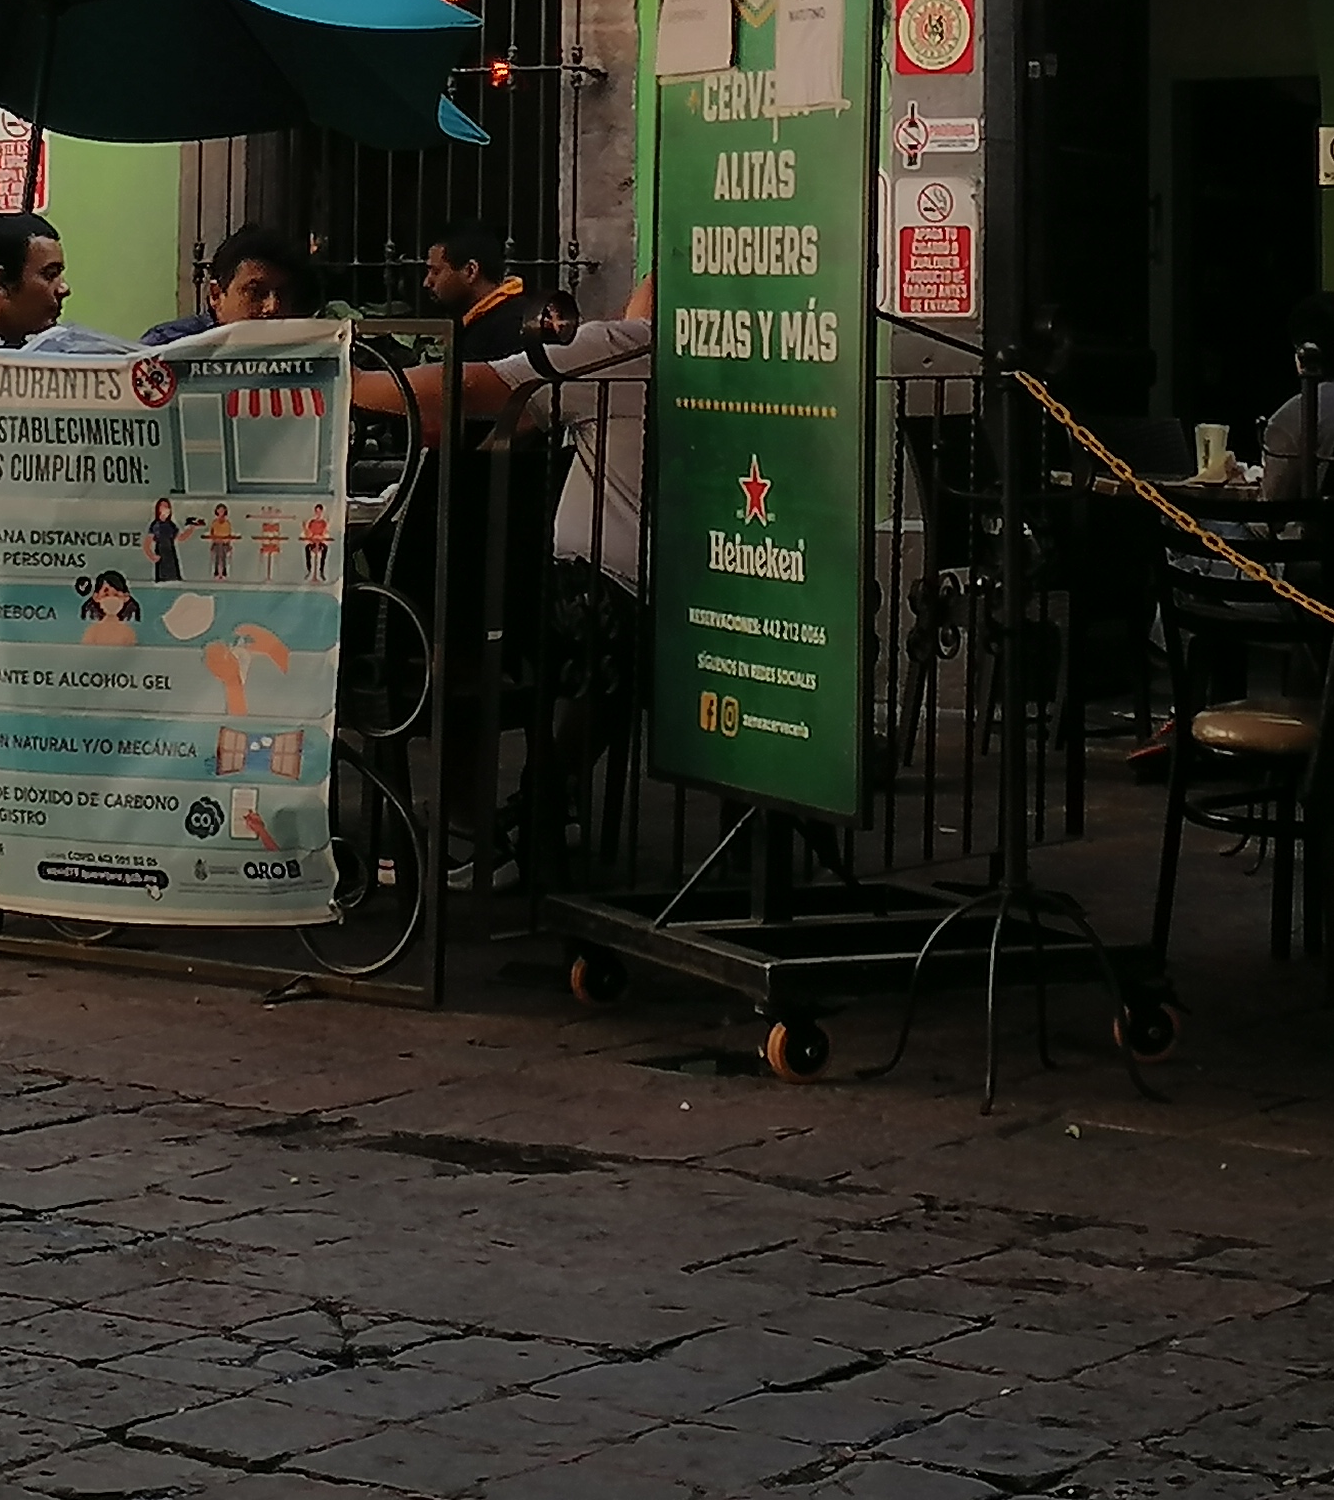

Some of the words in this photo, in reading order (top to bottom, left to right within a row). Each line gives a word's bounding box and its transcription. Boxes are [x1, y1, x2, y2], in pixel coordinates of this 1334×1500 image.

[702, 71, 810, 122] CERVE
[714, 150, 797, 201] ALITAS
[691, 225, 819, 276] BURGUERS
[675, 308, 752, 359] PIZZAS
[757, 310, 775, 360] Y
[780, 297, 839, 362] MÁS
[190, 360, 315, 376] RESTAURANTE
[10, 453, 96, 483] CUMPLIR
[103, 455, 150, 485] CON:
[30, 530, 114, 547] DISTANCIA
[119, 532, 142, 547] DE
[3, 551, 87, 568] PERSONAS
[708, 529, 805, 583] Heineken
[33, 670, 54, 687] DE
[58, 672, 138, 690] ALCOHOL
[142, 674, 172, 691] GEL
[13, 734, 79, 753] NATURAL
[82, 738, 114, 755] Y/O
[118, 736, 197, 758] MECÁNICA
[14, 785, 74, 806] DIÓXIDO
[77, 790, 100, 806] DE
[104, 792, 180, 812] CARBONO
